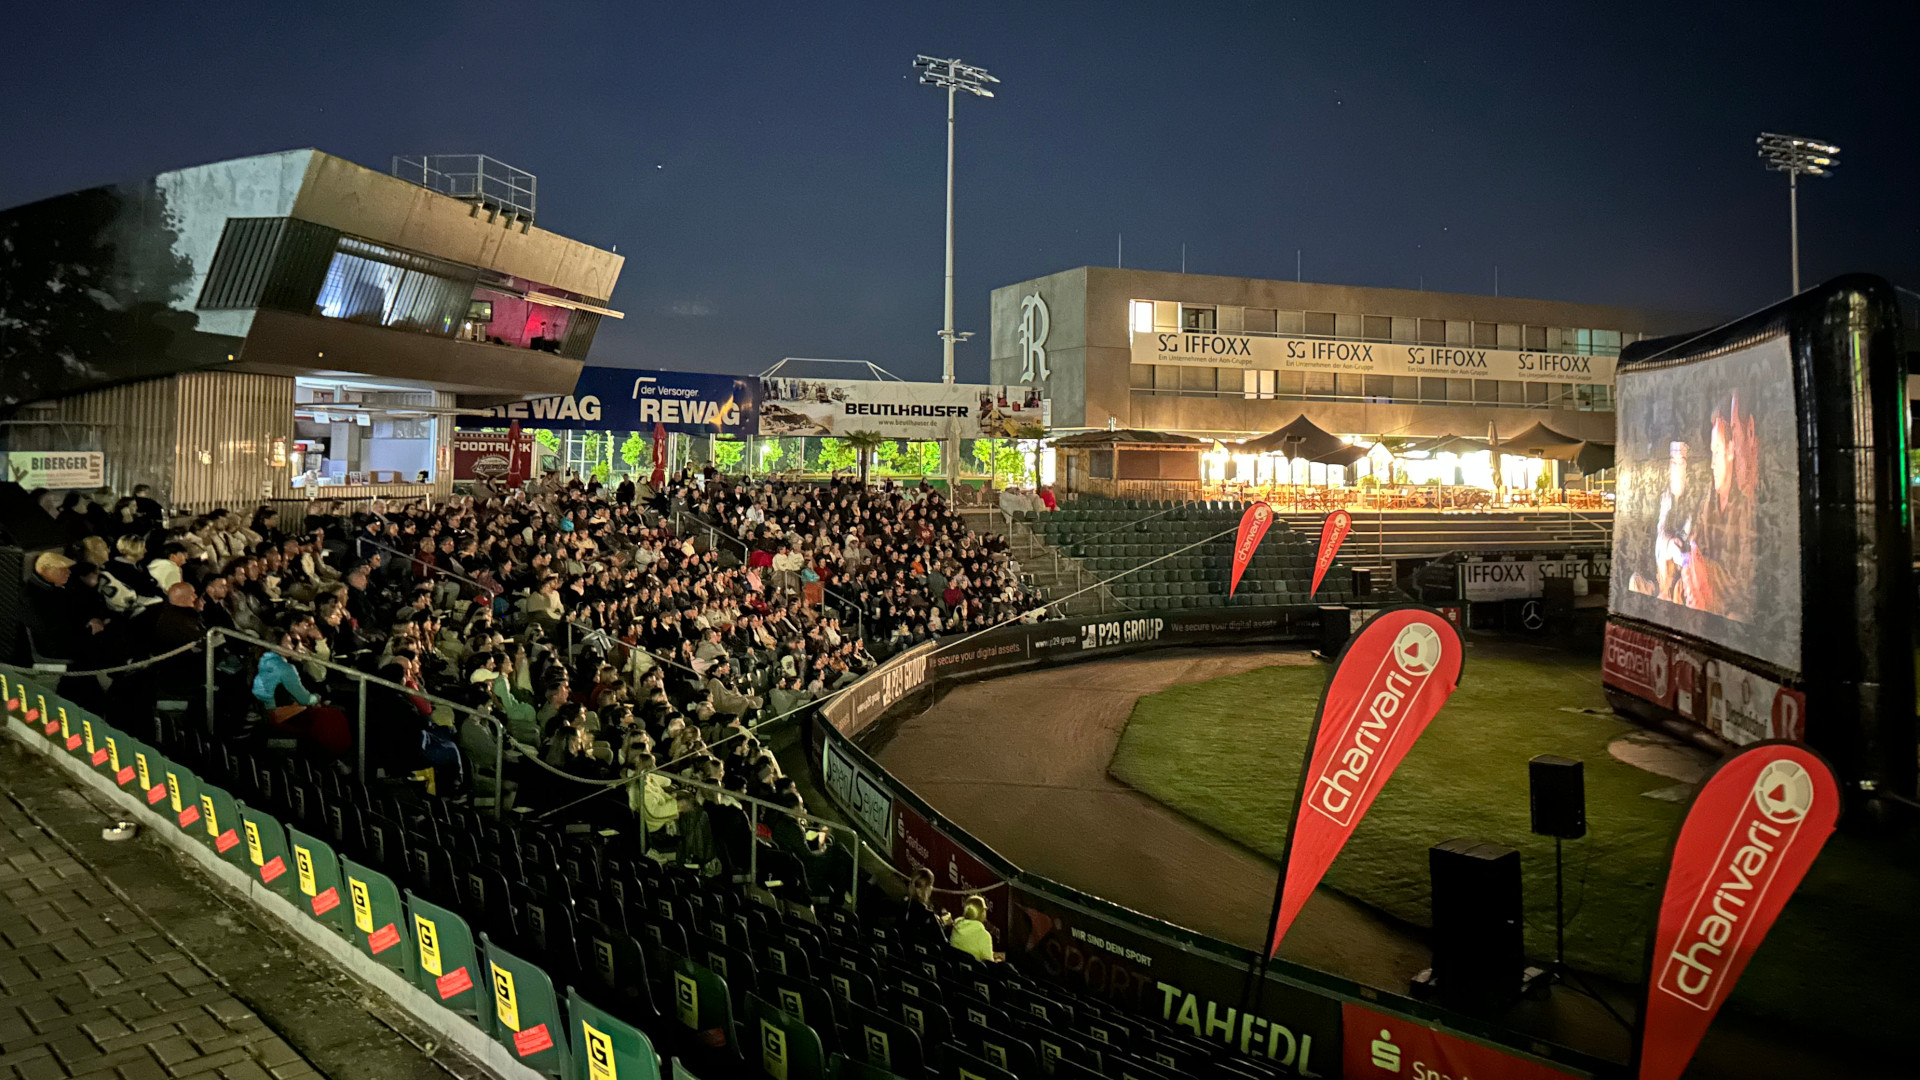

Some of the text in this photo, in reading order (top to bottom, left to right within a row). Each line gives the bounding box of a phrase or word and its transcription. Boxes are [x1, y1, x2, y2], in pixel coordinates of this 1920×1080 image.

[1158, 333, 1251, 356] SG IFFOXX
[1287, 341, 1373, 362] SG IFFOXX
[1168, 355, 1207, 363] Unternehmen
[1407, 347, 1487, 368] SG IFFOXX
[1518, 353, 1591, 373] SG IFFOXX
[640, 385, 656, 395] der
[640, 398, 741, 426] REWAG
[845, 402, 969, 419] BEUTLHAUSER
[31, 454, 101, 480] BIBERGER LIFT
[1468, 564, 1525, 583] IFFOXX
[1098, 621, 1120, 647] P29
[1122, 617, 1164, 643] GROUP
[1185, 622, 1210, 632] secure
[1211, 621, 1228, 632] your
[1229, 619, 1252, 632] digital
[937, 653, 959, 667] secure
[960, 651, 976, 664] your
[976, 646, 998, 660] digital
[1322, 670, 1412, 812] charivari
[1677, 819, 1782, 995] charivari
[418, 921, 434, 949] G
[1071, 926, 1153, 968] WIR SIND DEIN SPORT
[494, 970, 511, 1001] G
[587, 1031, 609, 1066] G
